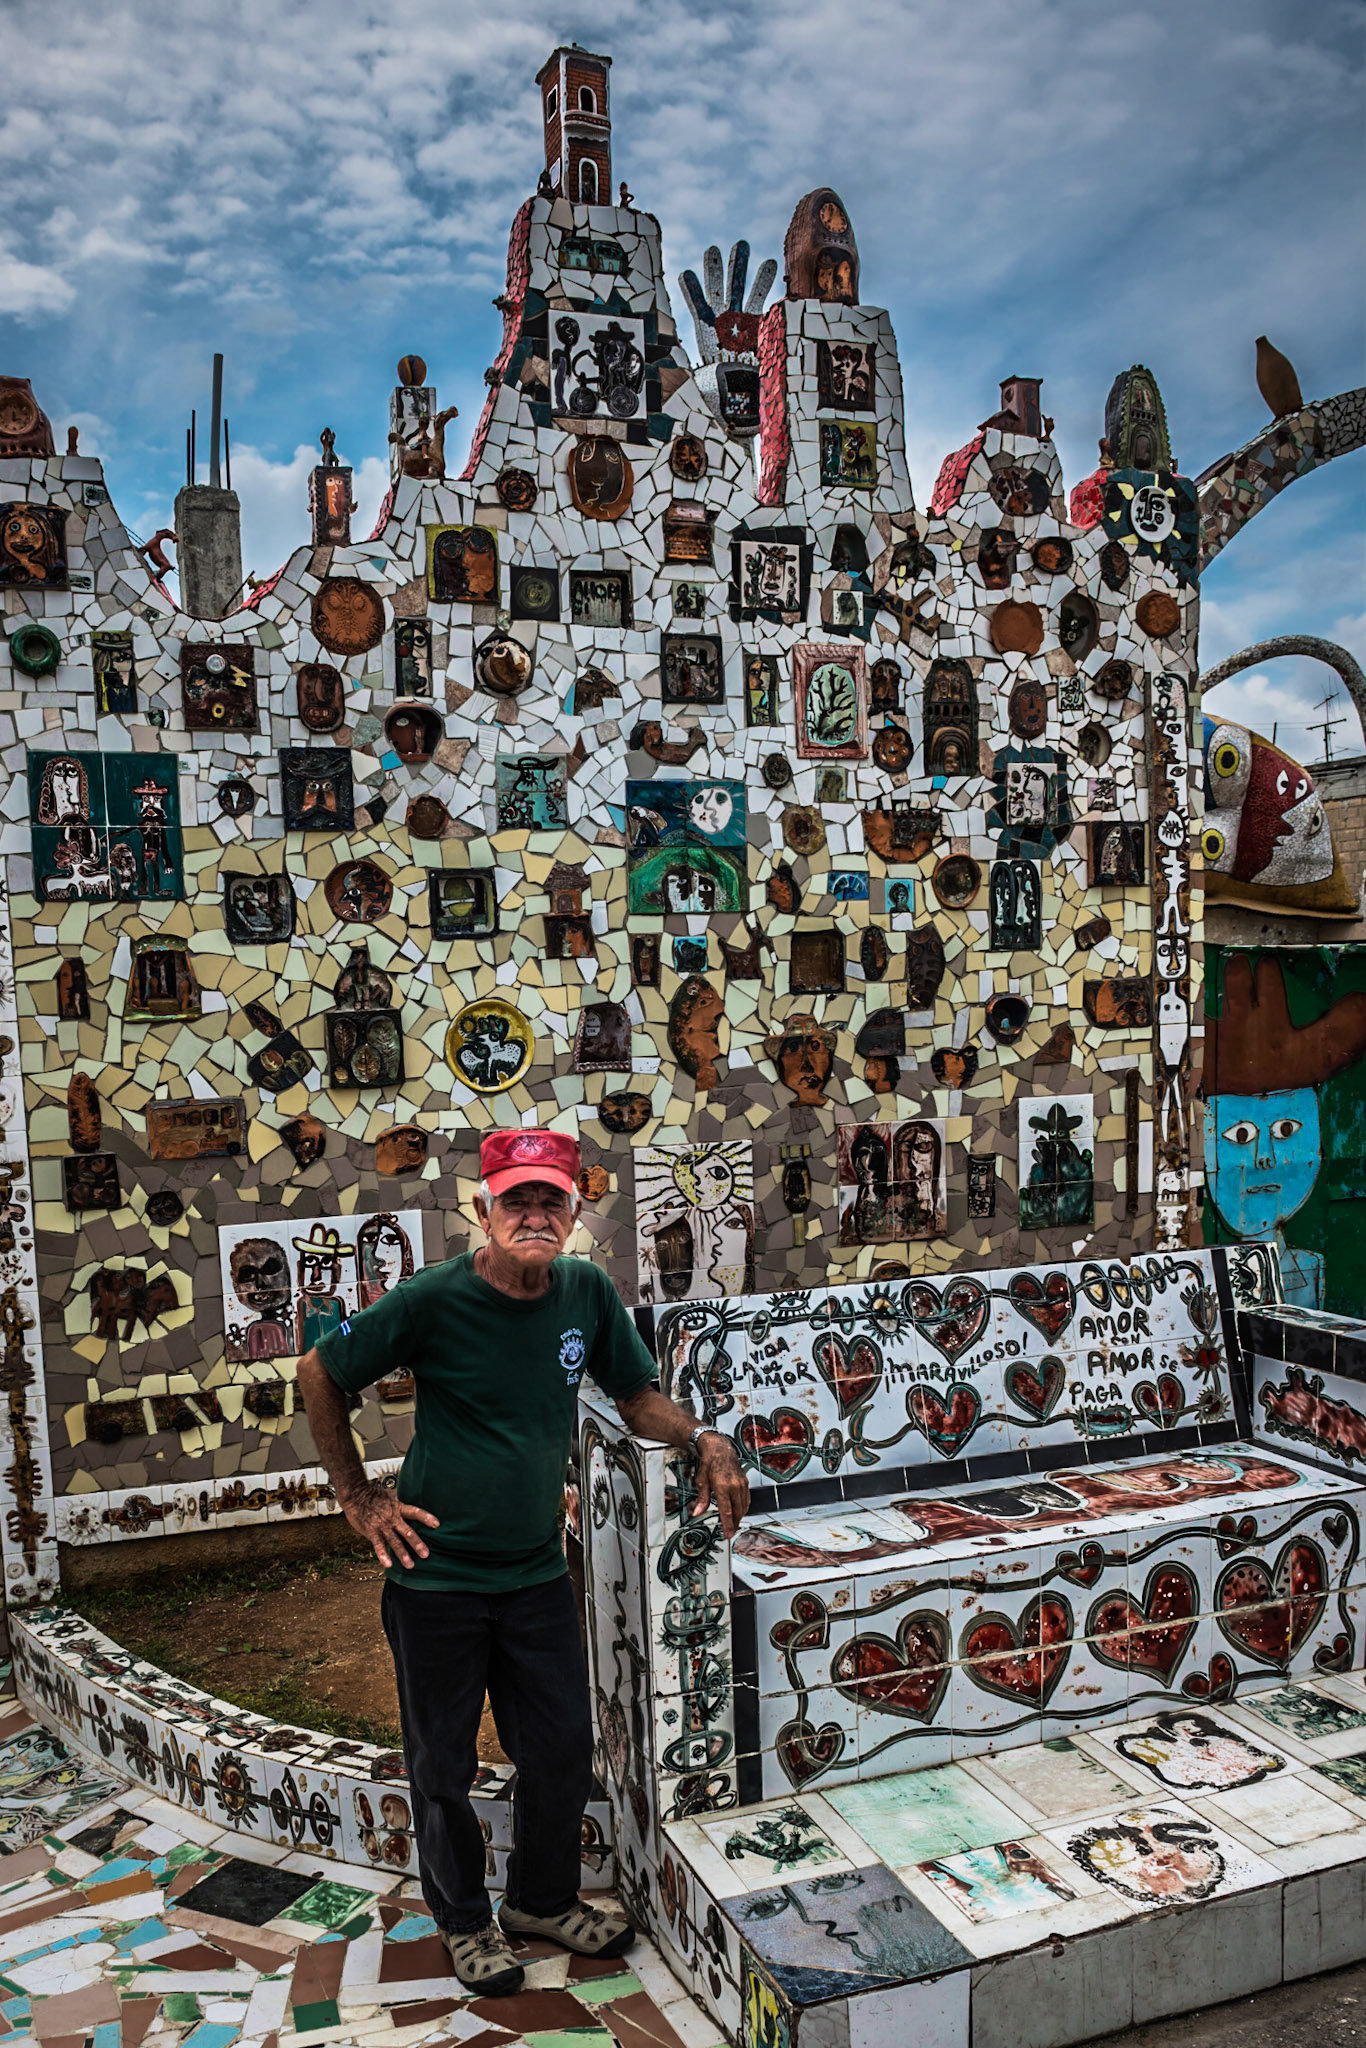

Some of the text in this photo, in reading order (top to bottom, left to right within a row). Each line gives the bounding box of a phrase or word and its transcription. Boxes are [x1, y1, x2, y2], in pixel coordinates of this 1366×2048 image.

[1079, 1306, 1153, 1340] AMOR
[733, 1336, 790, 1381] LA VIDA
[1087, 1346, 1155, 1377] AMOR
[752, 1362, 817, 1396] AMOR
[1069, 1381, 1123, 1405] PAGA
